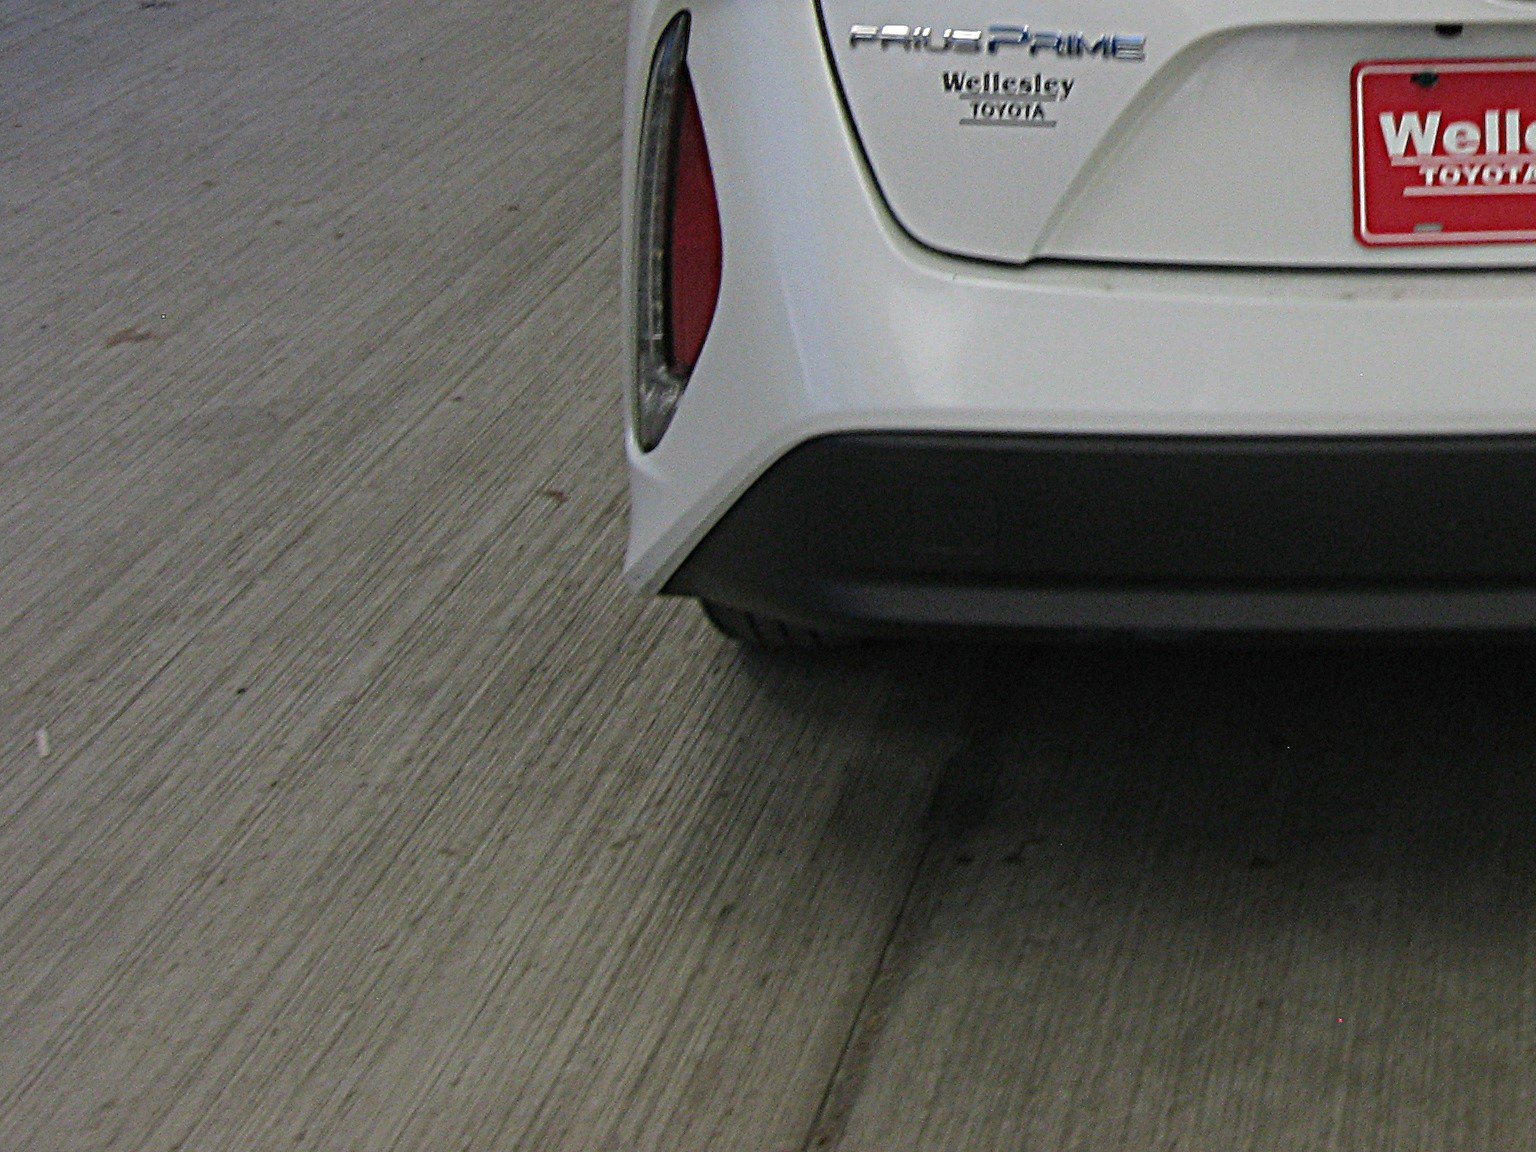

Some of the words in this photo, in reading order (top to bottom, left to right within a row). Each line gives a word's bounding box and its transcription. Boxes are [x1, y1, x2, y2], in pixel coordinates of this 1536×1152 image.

[850, 24, 982, 53] PRIUS
[988, 23, 1147, 61] PRIME
[943, 71, 1074, 99] Wellesley
[970, 101, 1046, 119] TOYOTA
